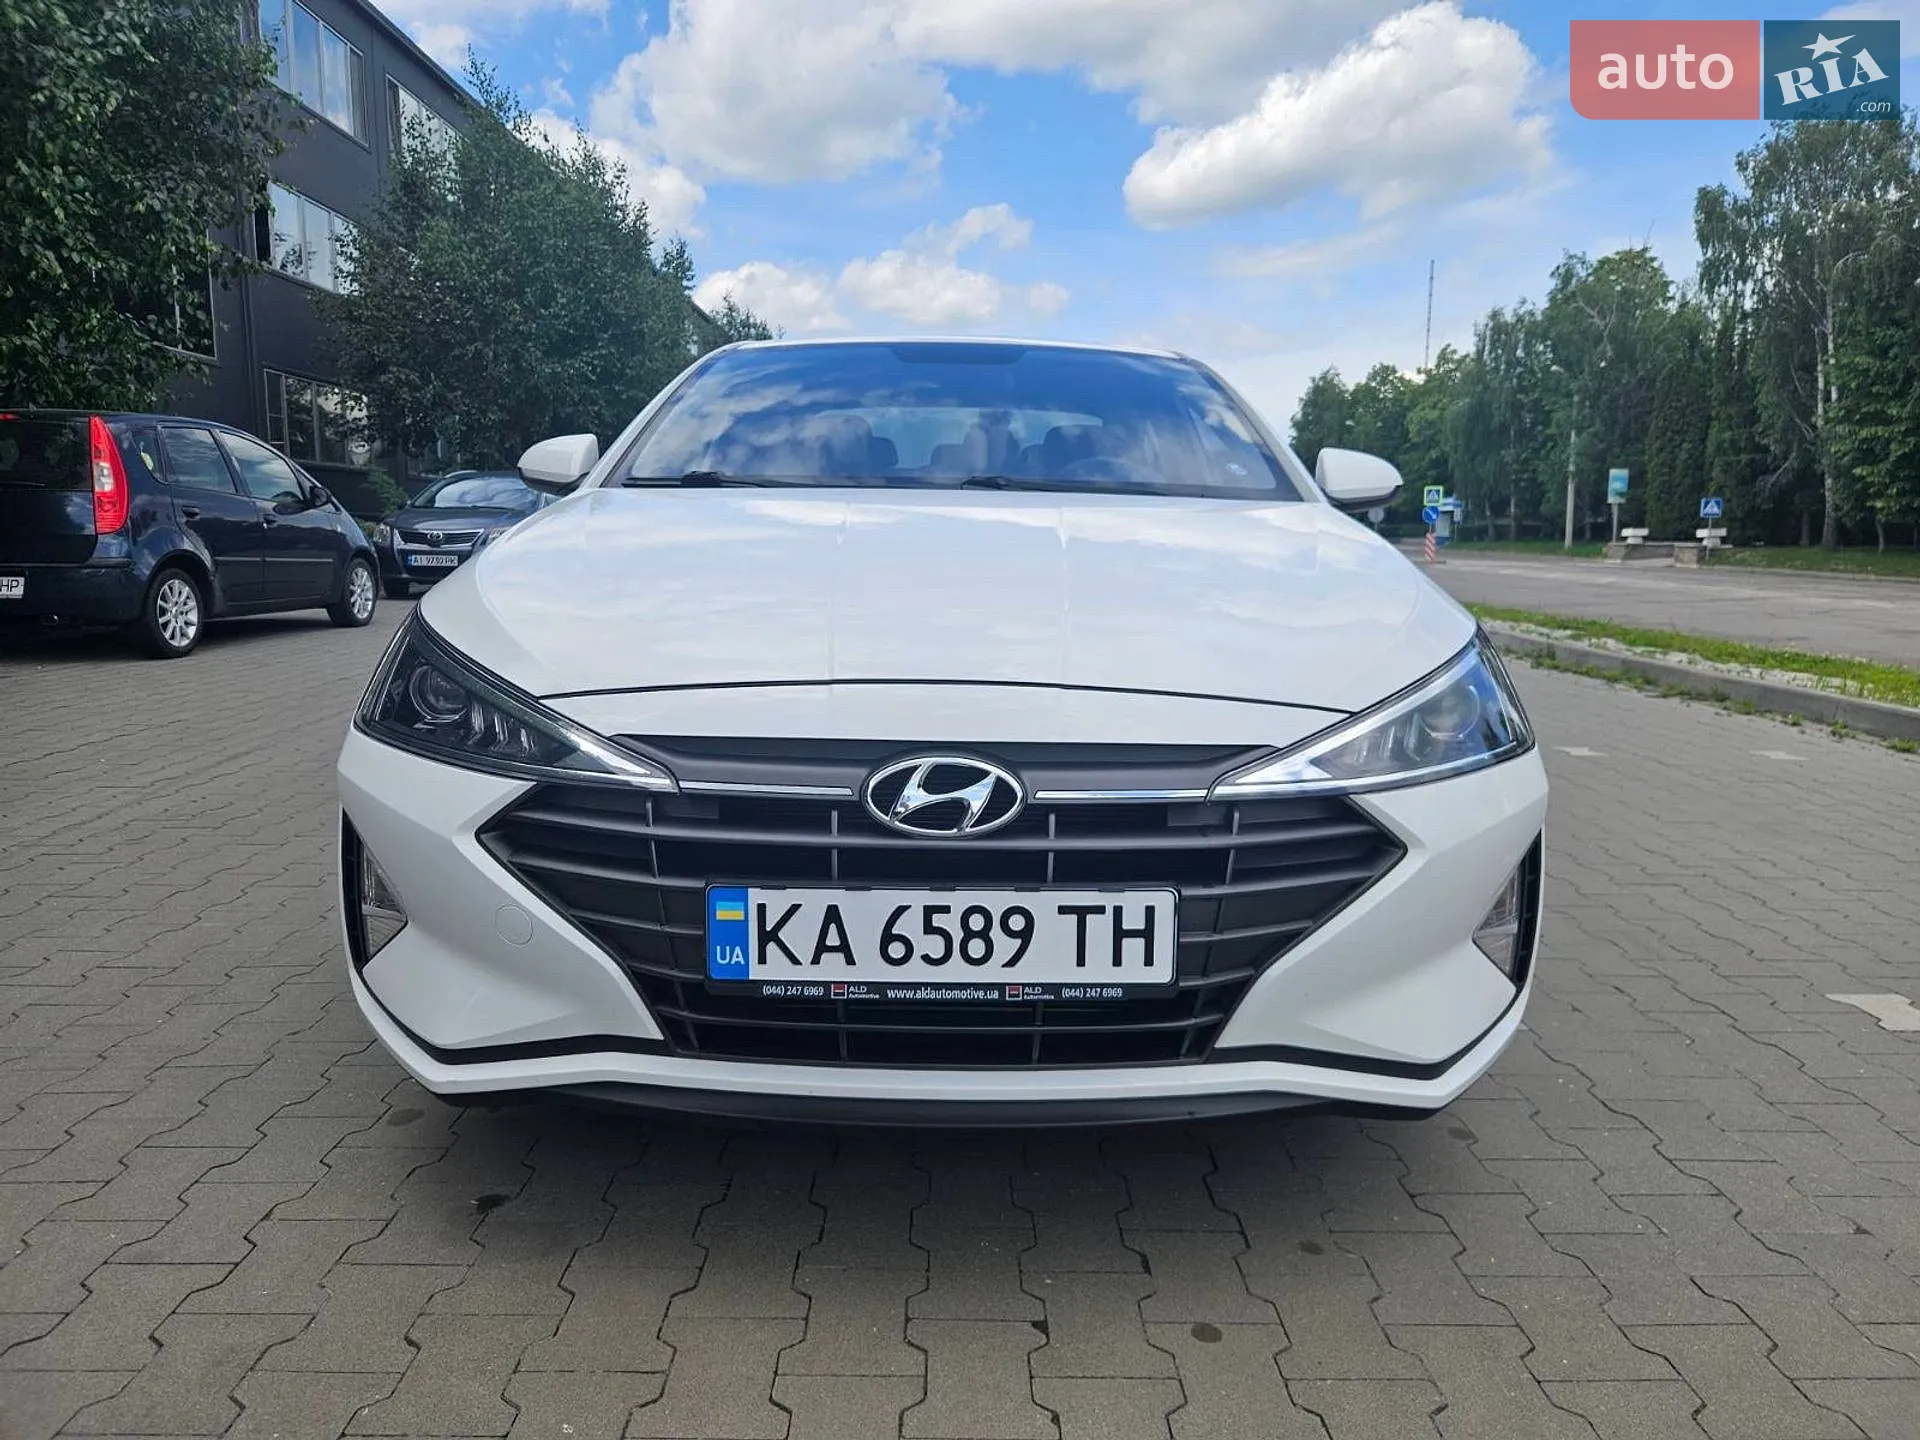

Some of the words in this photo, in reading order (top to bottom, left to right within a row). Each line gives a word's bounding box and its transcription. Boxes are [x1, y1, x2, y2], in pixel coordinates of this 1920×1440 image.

[756, 903, 857, 966] KA
[879, 904, 1036, 967] 6589
[1057, 904, 1155, 967] TH
[716, 946, 745, 965] UA
[762, 985, 785, 997] (044)
[786, 986, 802, 996] 247
[803, 986, 824, 996] 6969
[849, 985, 868, 993] ALD
[887, 986, 999, 999] www.aldautomotive.ua
[1023, 986, 1042, 994] ALD
[1061, 986, 1084, 998] (044)
[1085, 987, 1101, 997] 247
[1102, 987, 1123, 998] 6969
